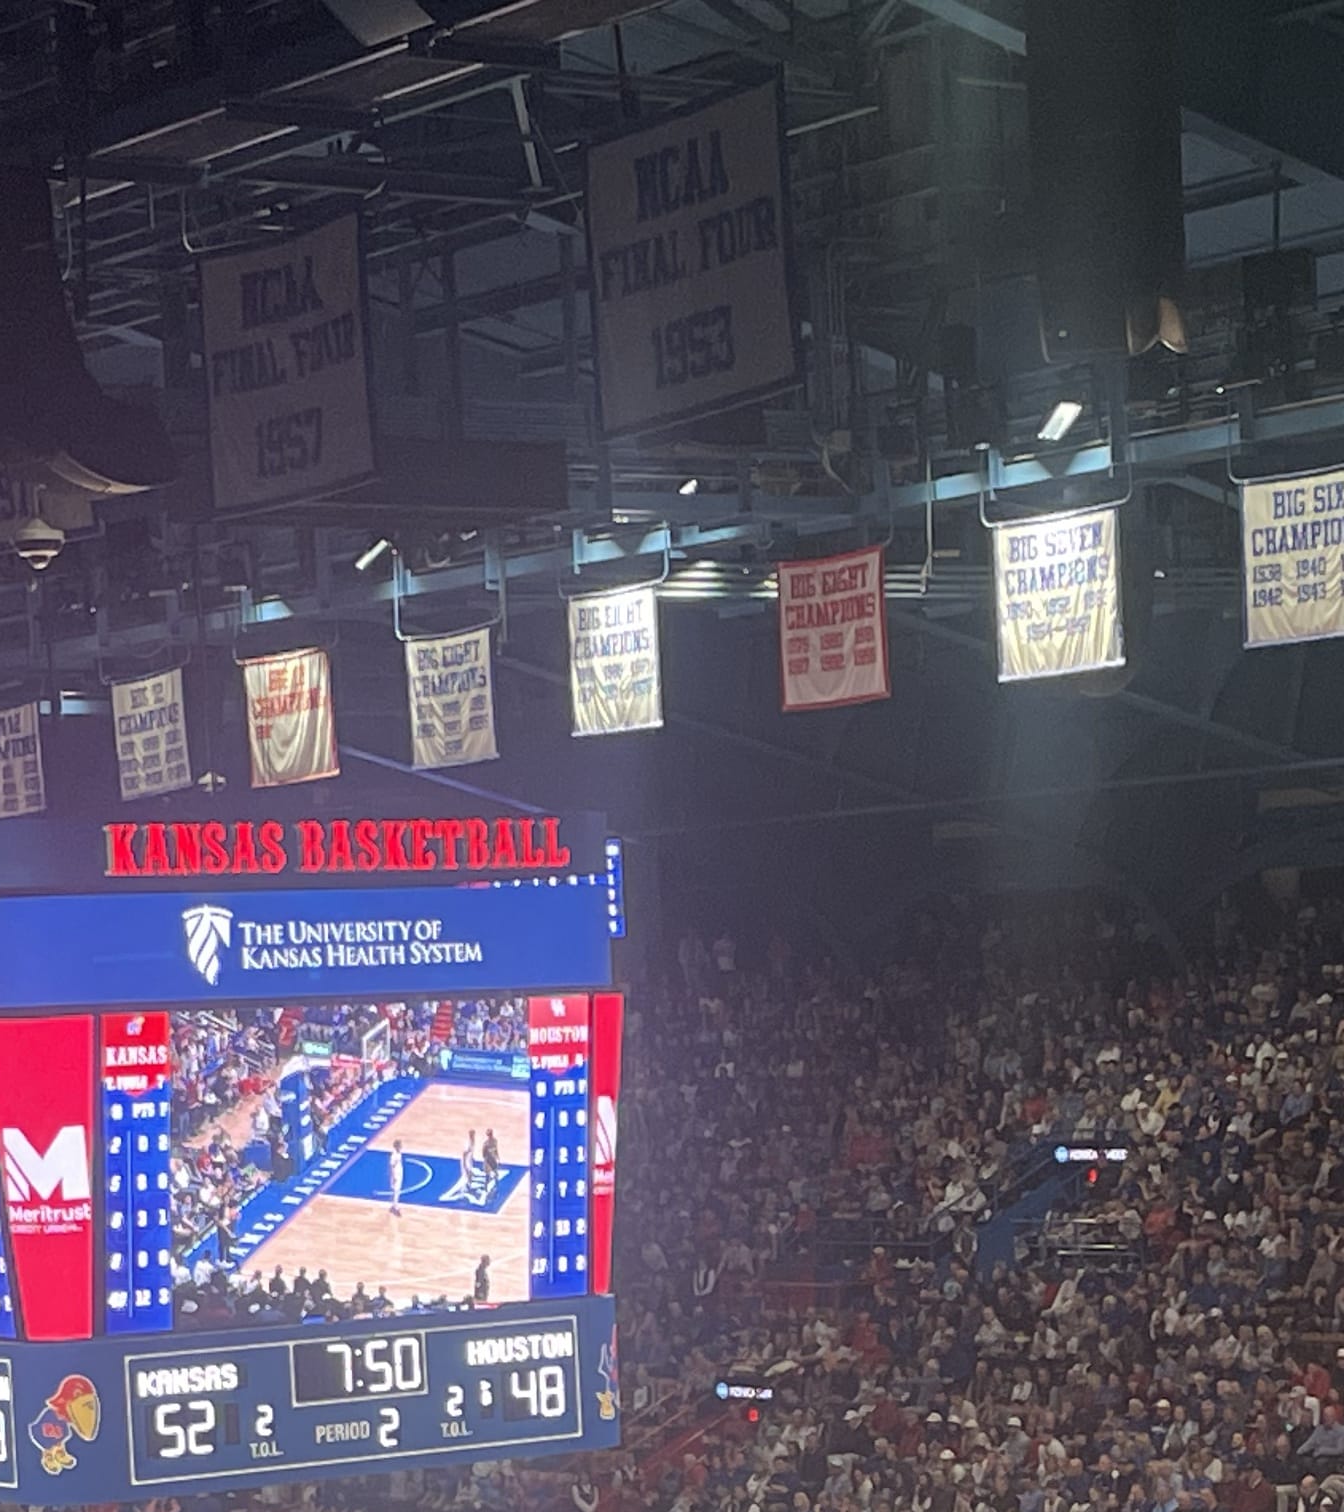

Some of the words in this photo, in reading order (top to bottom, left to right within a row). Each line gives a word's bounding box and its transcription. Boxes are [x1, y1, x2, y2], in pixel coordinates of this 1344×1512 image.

[634, 130, 730, 224] NCAA
[599, 230, 687, 298] FINAL
[697, 196, 778, 271] FOUR
[240, 256, 323, 328] NCAA
[213, 337, 288, 396] FINAL
[1273, 489, 1307, 520] BIG
[1009, 536, 1038, 564] BIG
[1045, 521, 1103, 556] SEVEN
[791, 568, 817, 599] BIG
[821, 563, 869, 597] EIGHT
[1006, 553, 1111, 597] CHAMPIONS
[577, 604, 599, 630] BIG
[605, 599, 645, 628] EIGHT
[785, 592, 875, 631] CHAMPIONS
[417, 648, 438, 670] BIG
[441, 638, 480, 668] EIGHT
[574, 629, 651, 660] CHAMPIONS
[413, 668, 486, 699] CHAMPIONS
[119, 702, 180, 735] CHAMPIONS
[105, 821, 288, 877] KANSAS
[297, 816, 571, 873] BASKETBALL
[239, 922, 284, 947] THE
[290, 920, 409, 944] UNIVERSITY
[414, 919, 442, 941] OF
[243, 946, 322, 970] KANSAS
[327, 945, 405, 968] HEALTH
[409, 942, 483, 965] SYSTEM
[530, 1025, 588, 1046] HOUSTON
[106, 1046, 168, 1067] KANSAS
[8, 1203, 92, 1224] Meritrust
[136, 1364, 239, 1399] KANSAS
[326, 1336, 423, 1394] 7:50
[466, 1332, 574, 1367] HOUSTON
[156, 1401, 216, 1459] 52
[256, 1404, 275, 1437] 2
[446, 1385, 464, 1417] 2
[509, 1365, 566, 1419] 48
[378, 1407, 400, 1448] 2
[314, 1421, 371, 1444] PERIOD
